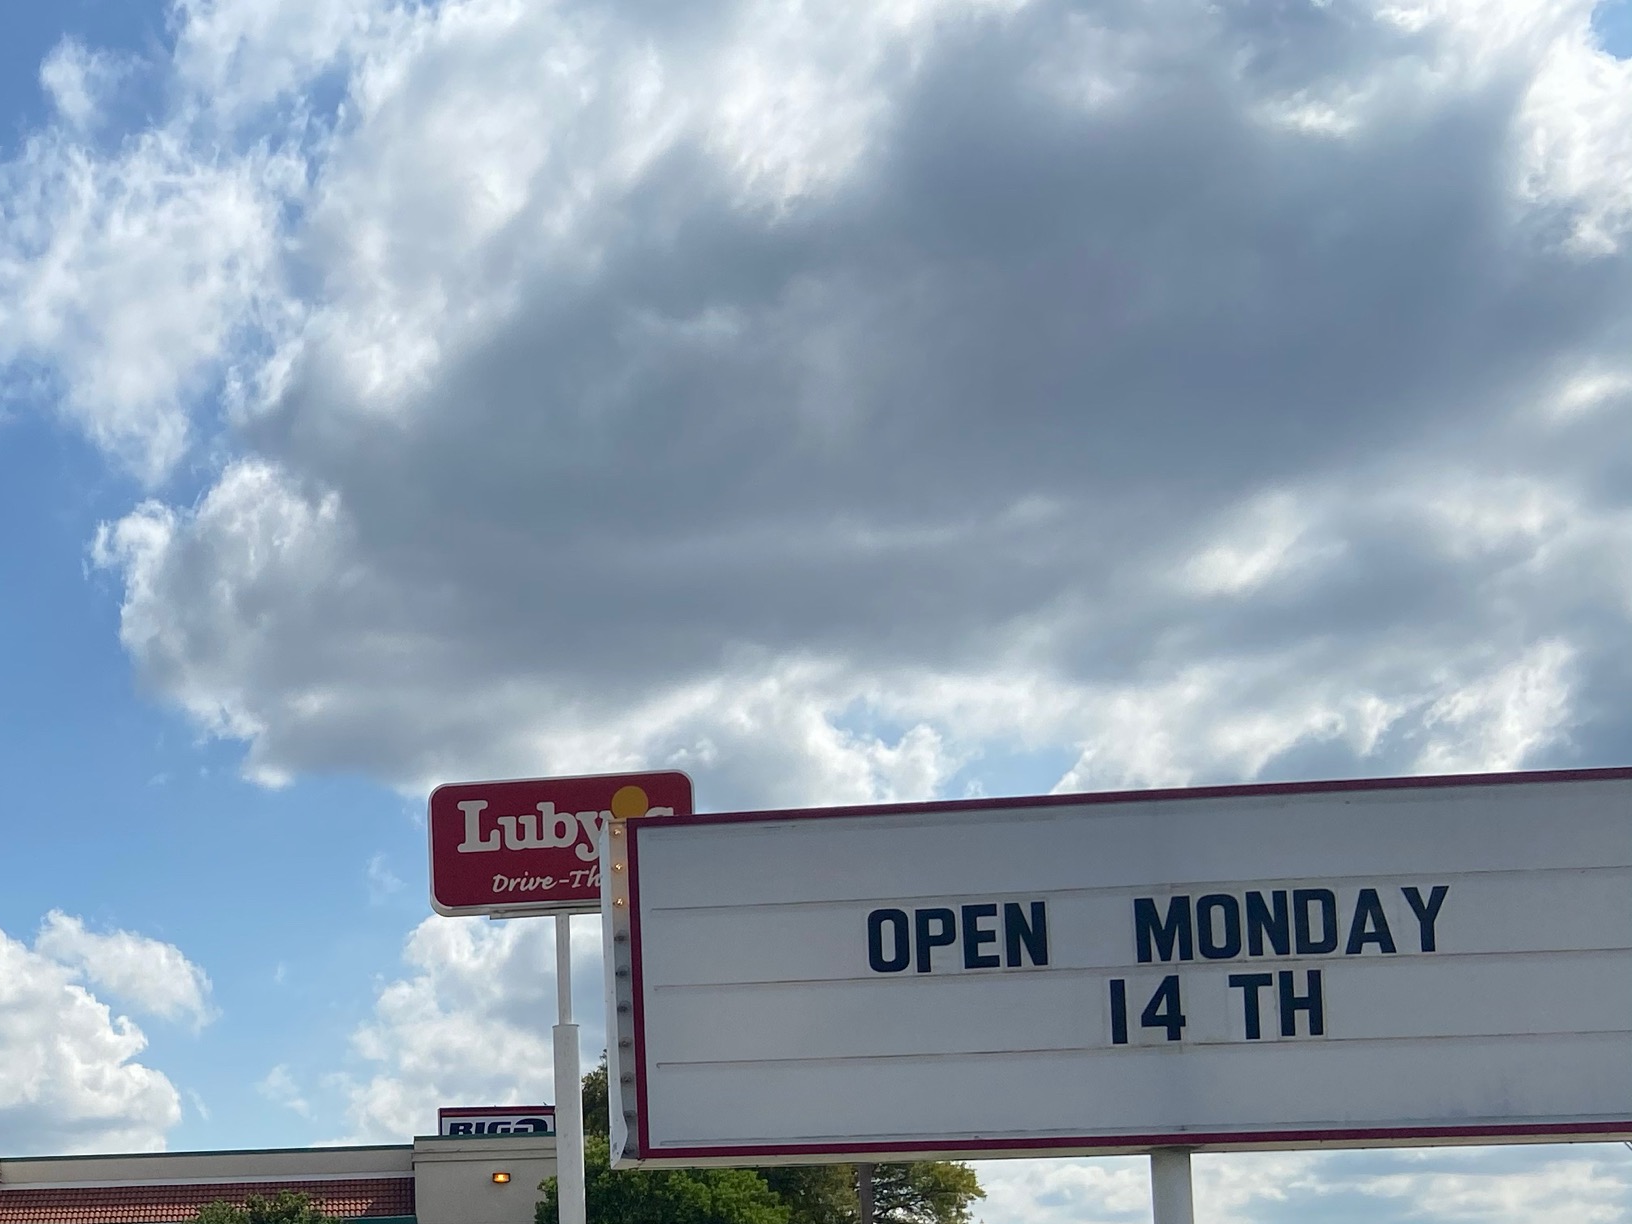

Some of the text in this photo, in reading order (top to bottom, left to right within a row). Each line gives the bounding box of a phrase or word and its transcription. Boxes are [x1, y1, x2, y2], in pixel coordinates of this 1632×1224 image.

[457, 786, 674, 861] Luby'
[867, 886, 1449, 973] OPEN MONDAY
[1110, 970, 1324, 1045] 14 TH
